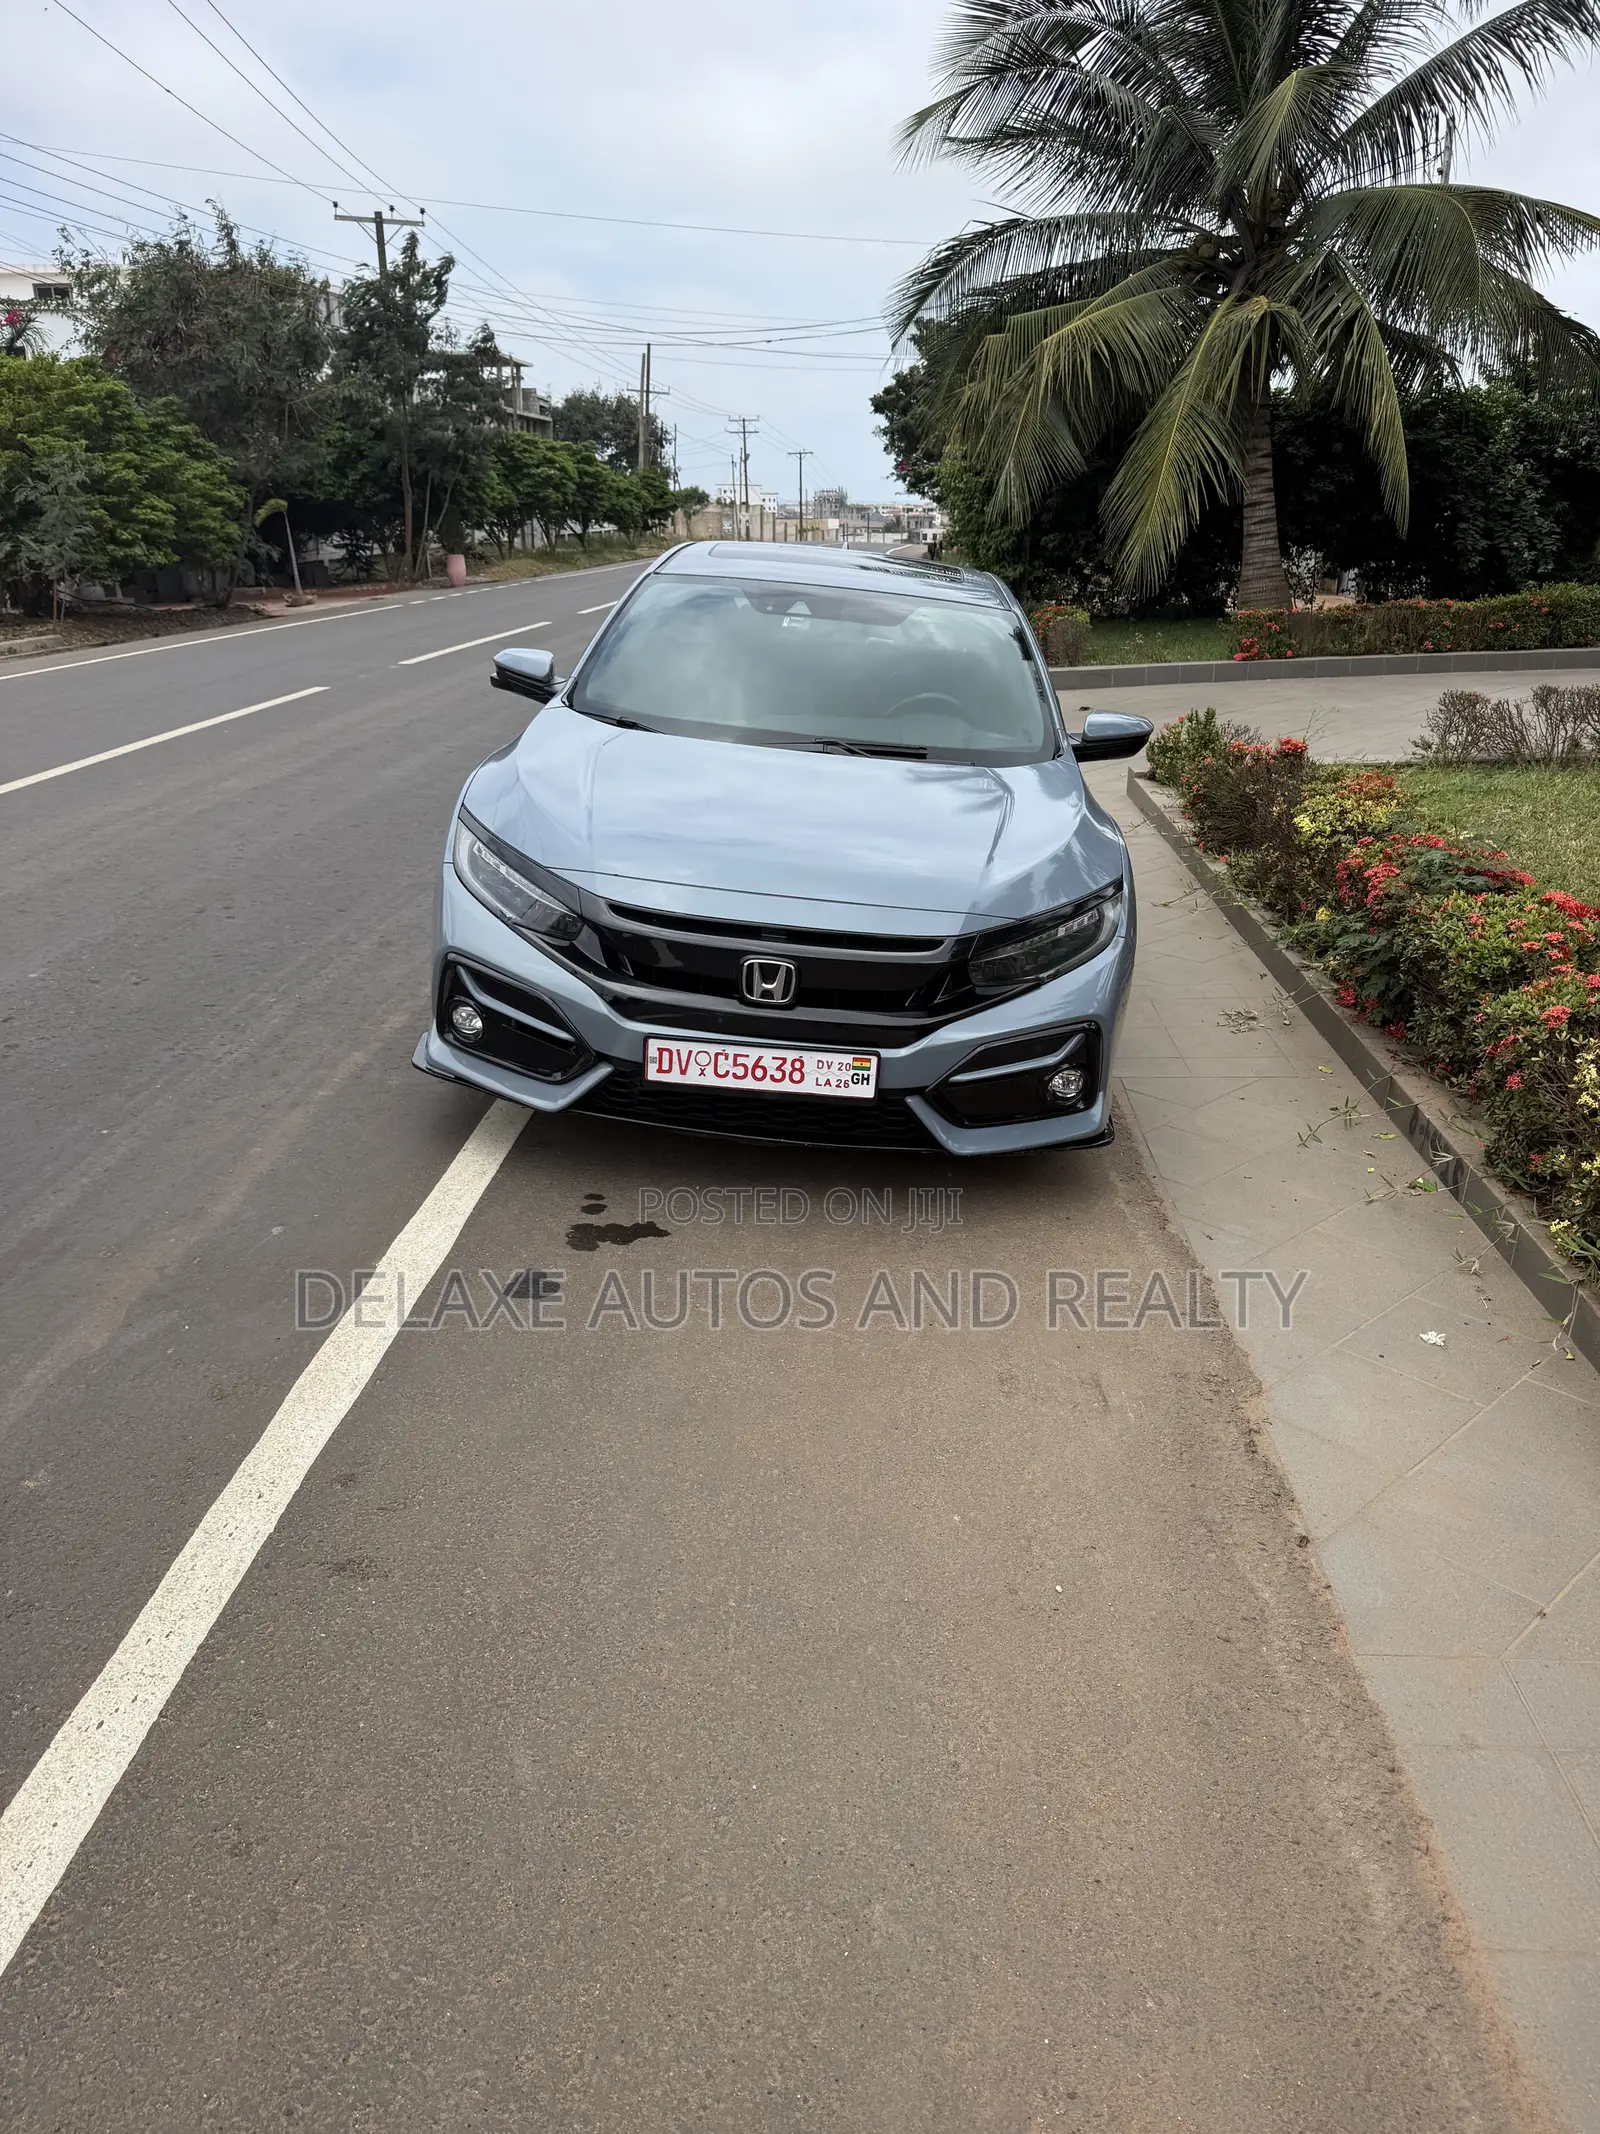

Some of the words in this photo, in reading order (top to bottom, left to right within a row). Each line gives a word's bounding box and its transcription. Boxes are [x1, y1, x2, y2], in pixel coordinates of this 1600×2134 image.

[656, 1047, 694, 1076] DV
[713, 1051, 806, 1085] C5638
[816, 1059, 834, 1071] DV
[837, 1061, 852, 1072] 20
[815, 1076, 832, 1088] LA
[835, 1078, 850, 1089] 26
[851, 1072, 871, 1086] GH
